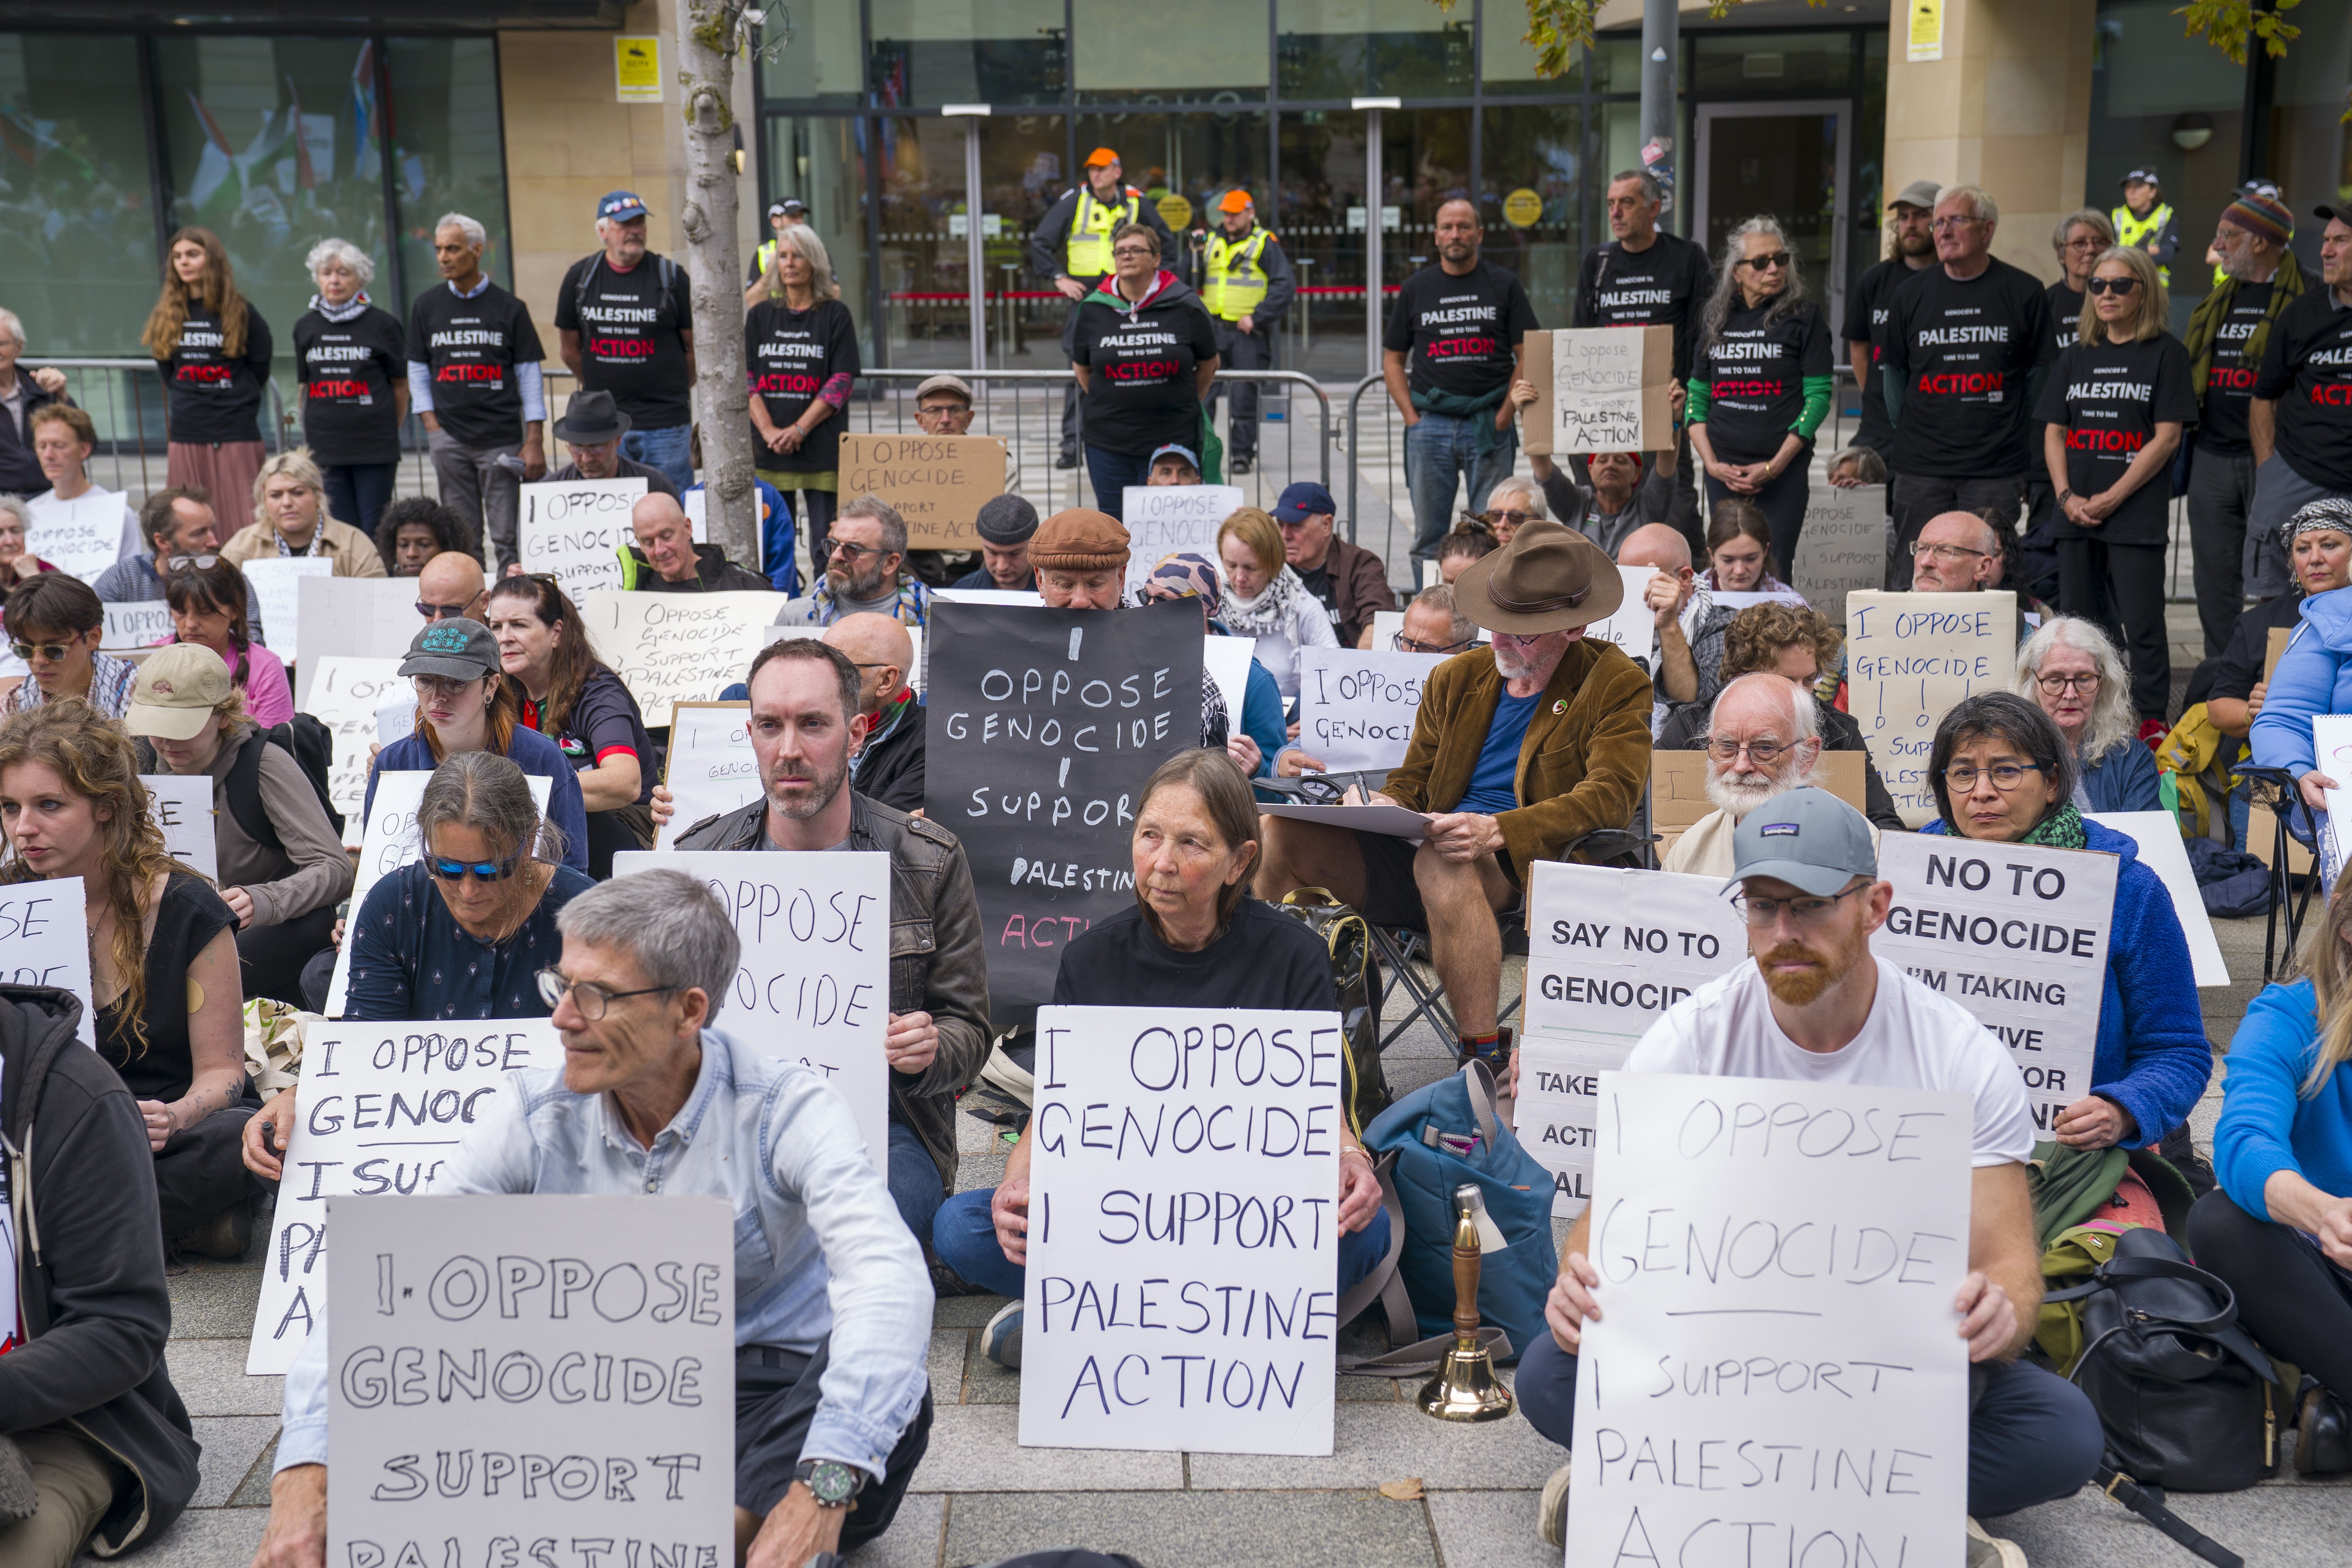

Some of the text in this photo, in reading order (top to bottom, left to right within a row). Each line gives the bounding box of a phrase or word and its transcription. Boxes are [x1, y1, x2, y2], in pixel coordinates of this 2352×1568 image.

[1600, 289, 1671, 308] PALESTINE
[581, 306, 657, 322] PALESTINE
[1421, 306, 1496, 326] PALESTINE
[1944, 308, 1974, 316] GENOCIDE
[431, 330, 503, 347] PALESTINE
[590, 337, 654, 357] ACTION
[1100, 333, 1177, 348] PALESTINE
[1427, 337, 1495, 357] ACTION
[1919, 326, 2008, 346] PALESTINE
[758, 343, 824, 359] PALESTINE
[1563, 339, 1628, 366] I oppose
[1709, 342, 1782, 360] PALESTINE
[2309, 346, 2352, 365] PALE
[436, 364, 502, 382] ACTION
[1105, 359, 1179, 379] ACTION
[1558, 365, 1638, 391] GENOCIDE
[1743, 366, 1761, 374] TAKE
[2209, 368, 2259, 388] CTIO
[309, 380, 370, 398] ACTION
[757, 374, 820, 393] ACTION
[1711, 379, 1782, 399] ACTION
[1919, 372, 2003, 394] ACTION
[2066, 381, 2152, 402] PALESTINE
[2311, 384, 2352, 406] ACT
[1559, 398, 1635, 412] I SUPPORT
[1563, 410, 1637, 428] PALESTINE
[855, 440, 958, 464] I OPPOSE
[2065, 428, 2143, 451] ACTION
[1141, 495, 1219, 516] I OPPOSE
[1834, 488, 1836, 501] I
[71, 502, 77, 522] I
[529, 491, 645, 524] I OPPOSE
[894, 502, 936, 513] PPORT
[1805, 507, 1854, 521] OPPOSE
[30, 524, 97, 542] OPPOSE
[527, 527, 641, 557] GENOCID
[944, 521, 981, 539] ACT
[1128, 520, 1222, 548] GENOCID
[1801, 523, 1875, 540] GENOCIDE
[33, 537, 114, 558] GENOCIDE
[1803, 551, 1881, 567] I SUPPORT
[1798, 575, 1875, 590] PALESTINE
[109, 612, 115, 636] I
[614, 602, 729, 629] I OPPOSE
[1852, 607, 1993, 640] I OPPOSE
[636, 624, 747, 650] GENOCIDE
[1068, 626, 1083, 661] I
[1585, 619, 1626, 646] cide
[645, 648, 743, 667] SUPPORT
[326, 668, 336, 693] I
[627, 663, 744, 686] PALESTINE
[1315, 669, 1426, 705] I OPPOS
[980, 667, 1173, 708] OPPOSE
[692, 729, 696, 748] I
[946, 711, 1171, 752] GENOCIDE
[1316, 718, 1412, 748] GENOCI
[1059, 757, 1071, 788] I
[1666, 770, 1686, 801] I
[741, 794, 743, 807] I
[967, 786, 1134, 826] SUPPOR
[1010, 857, 1135, 891] PALESTIN
[1926, 854, 2065, 900] NO TO
[1552, 920, 1720, 959] SAY NO TO
[1886, 906, 2096, 958] GENOCIDE
[736, 967, 873, 1028] OCIDE
[1541, 974, 1691, 1012] GENOCID
[1907, 967, 2066, 1006] I'M TAKING
[1983, 1024, 2044, 1052] TIVE
[316, 1033, 531, 1077] I OPPOSE
[1043, 1023, 1338, 1091] I OPPOSE
[1536, 1071, 1598, 1096] TAKE
[2019, 1065, 2066, 1091] OR
[308, 1087, 497, 1136] GENOC
[1039, 1101, 1334, 1160] GENOCIDE
[1542, 1124, 1596, 1148] ACTI
[1612, 1092, 1946, 1162] I OPPOSE
[297, 1162, 344, 1201] I
[1043, 1190, 1330, 1250] I SUPPORT
[1598, 1197, 1957, 1285] GENOCIDE
[428, 1254, 722, 1326] OPPOSE
[1041, 1277, 1337, 1340] PALESTINE
[340, 1345, 703, 1409] GENOCIDE
[1061, 1354, 1305, 1419] ACTION
[1593, 1355, 1915, 1411] I SUPPORT
[370, 1449, 701, 1502] SUPPORT
[1594, 1428, 1933, 1498] PALESTINE
[1610, 1505, 1909, 1568] ACTION
